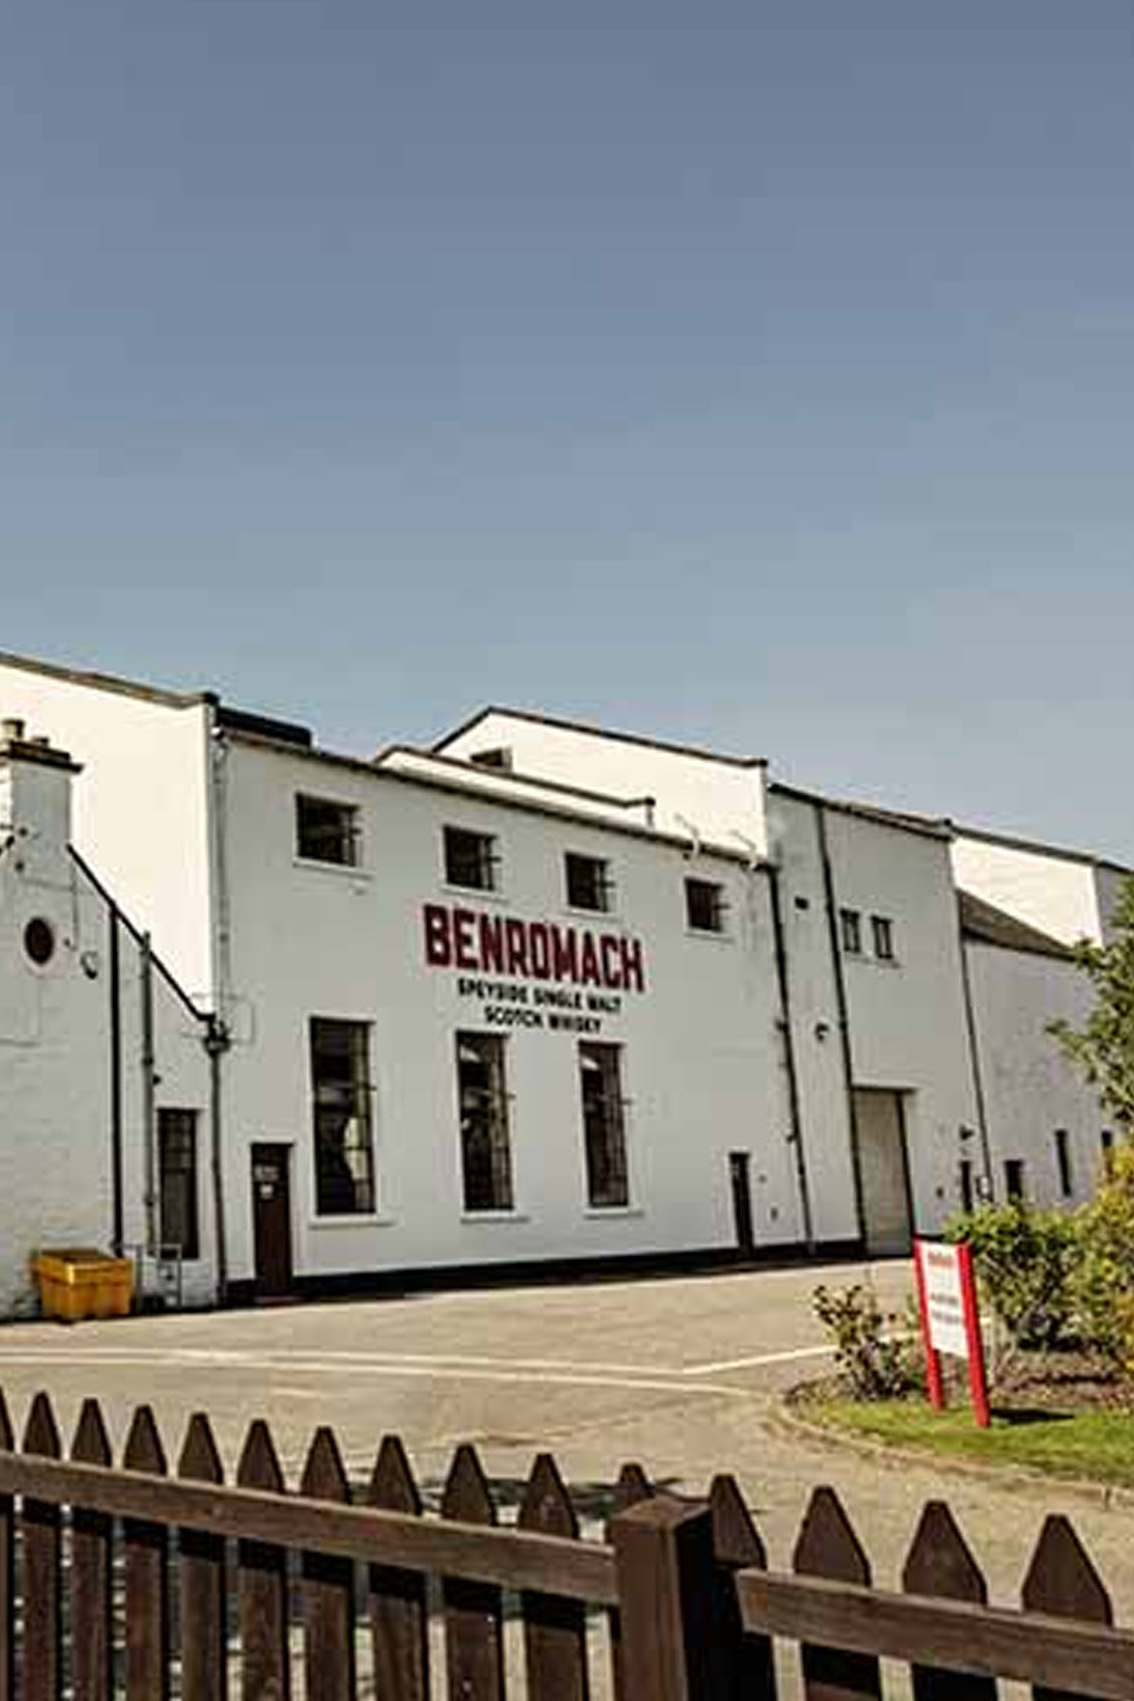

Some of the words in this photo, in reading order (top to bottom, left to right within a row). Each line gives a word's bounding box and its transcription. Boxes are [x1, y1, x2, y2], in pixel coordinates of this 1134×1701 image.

[423, 903, 644, 993] BENROMACH
[457, 978, 527, 1000] SPEYSIDE
[533, 987, 583, 1010] SINGLE
[587, 996, 621, 1013] MALT
[484, 1005, 543, 1028] SCOTCH
[548, 1014, 601, 1032] WHISKY
